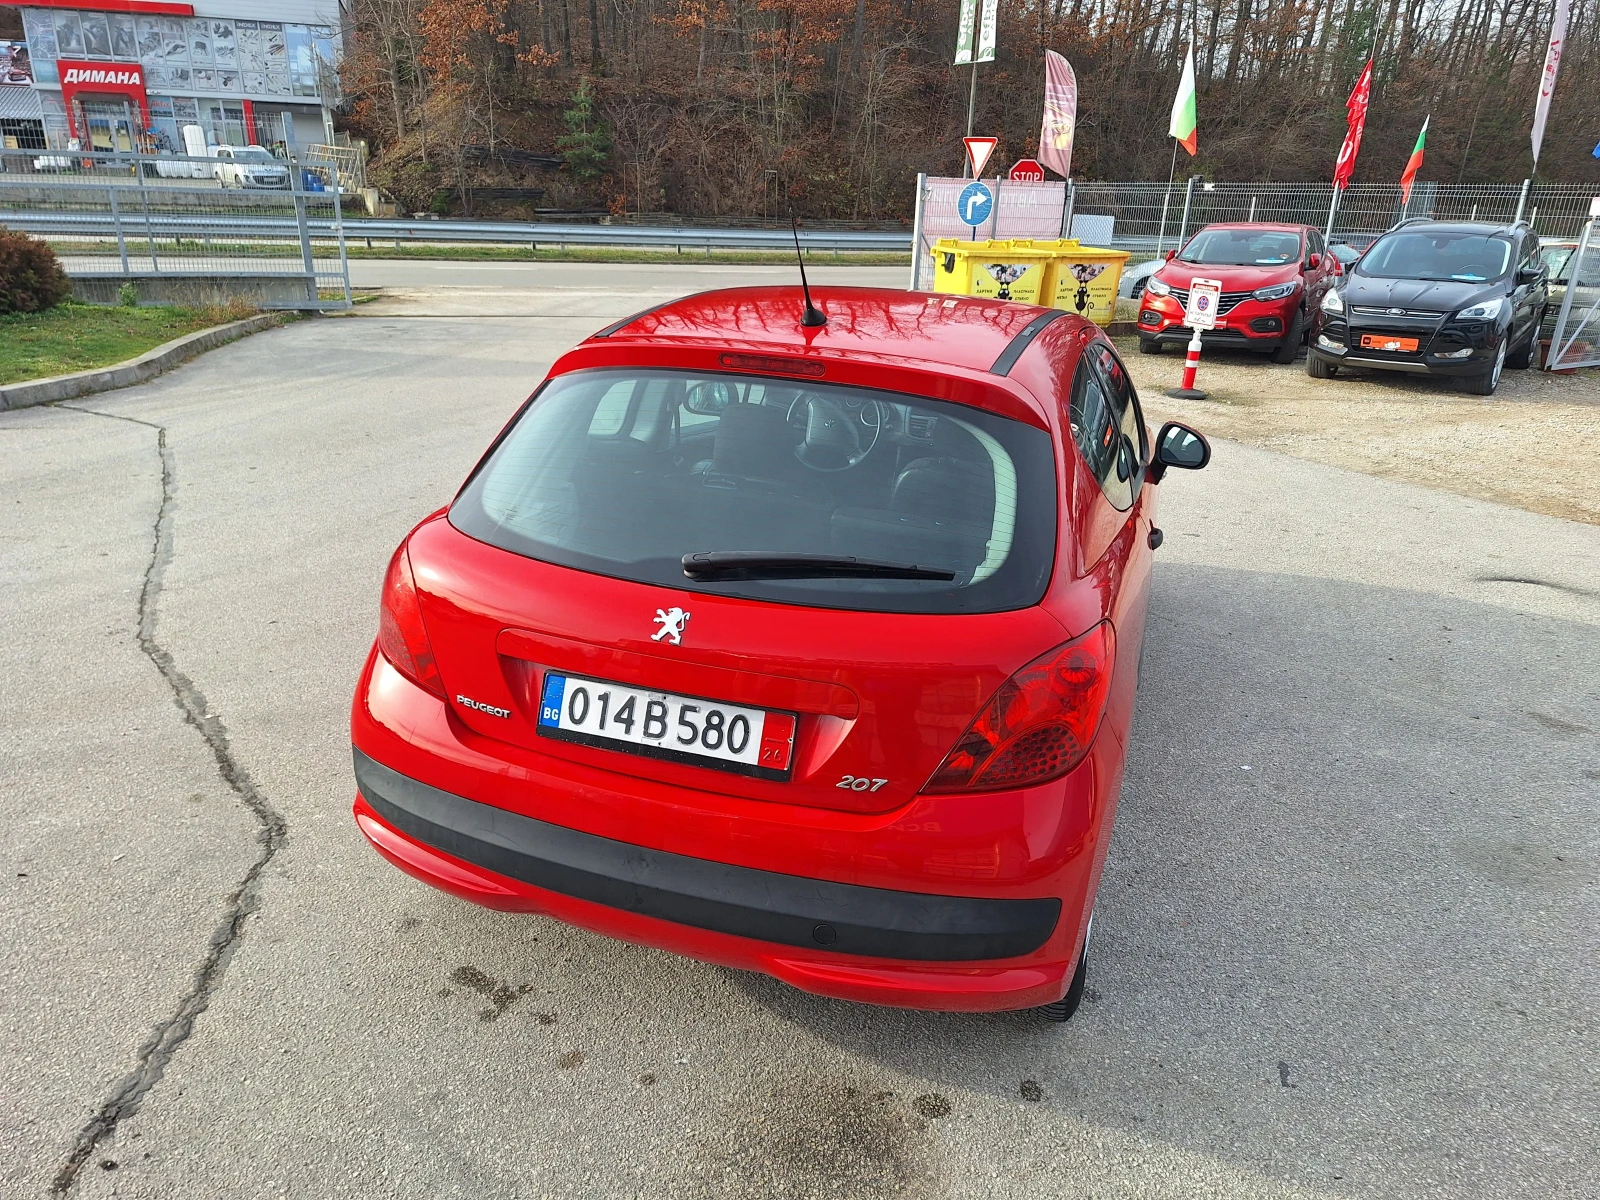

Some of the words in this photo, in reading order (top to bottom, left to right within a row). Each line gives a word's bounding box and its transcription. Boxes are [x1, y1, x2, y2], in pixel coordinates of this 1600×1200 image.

[64, 69, 140, 84] ДИМАНА
[1013, 171, 1041, 182] STOP
[456, 694, 511, 719] PEUGEOT
[543, 706, 560, 721] BG
[568, 686, 750, 755] 014B580
[762, 747, 783, 763] 26
[835, 774, 889, 793] 207
